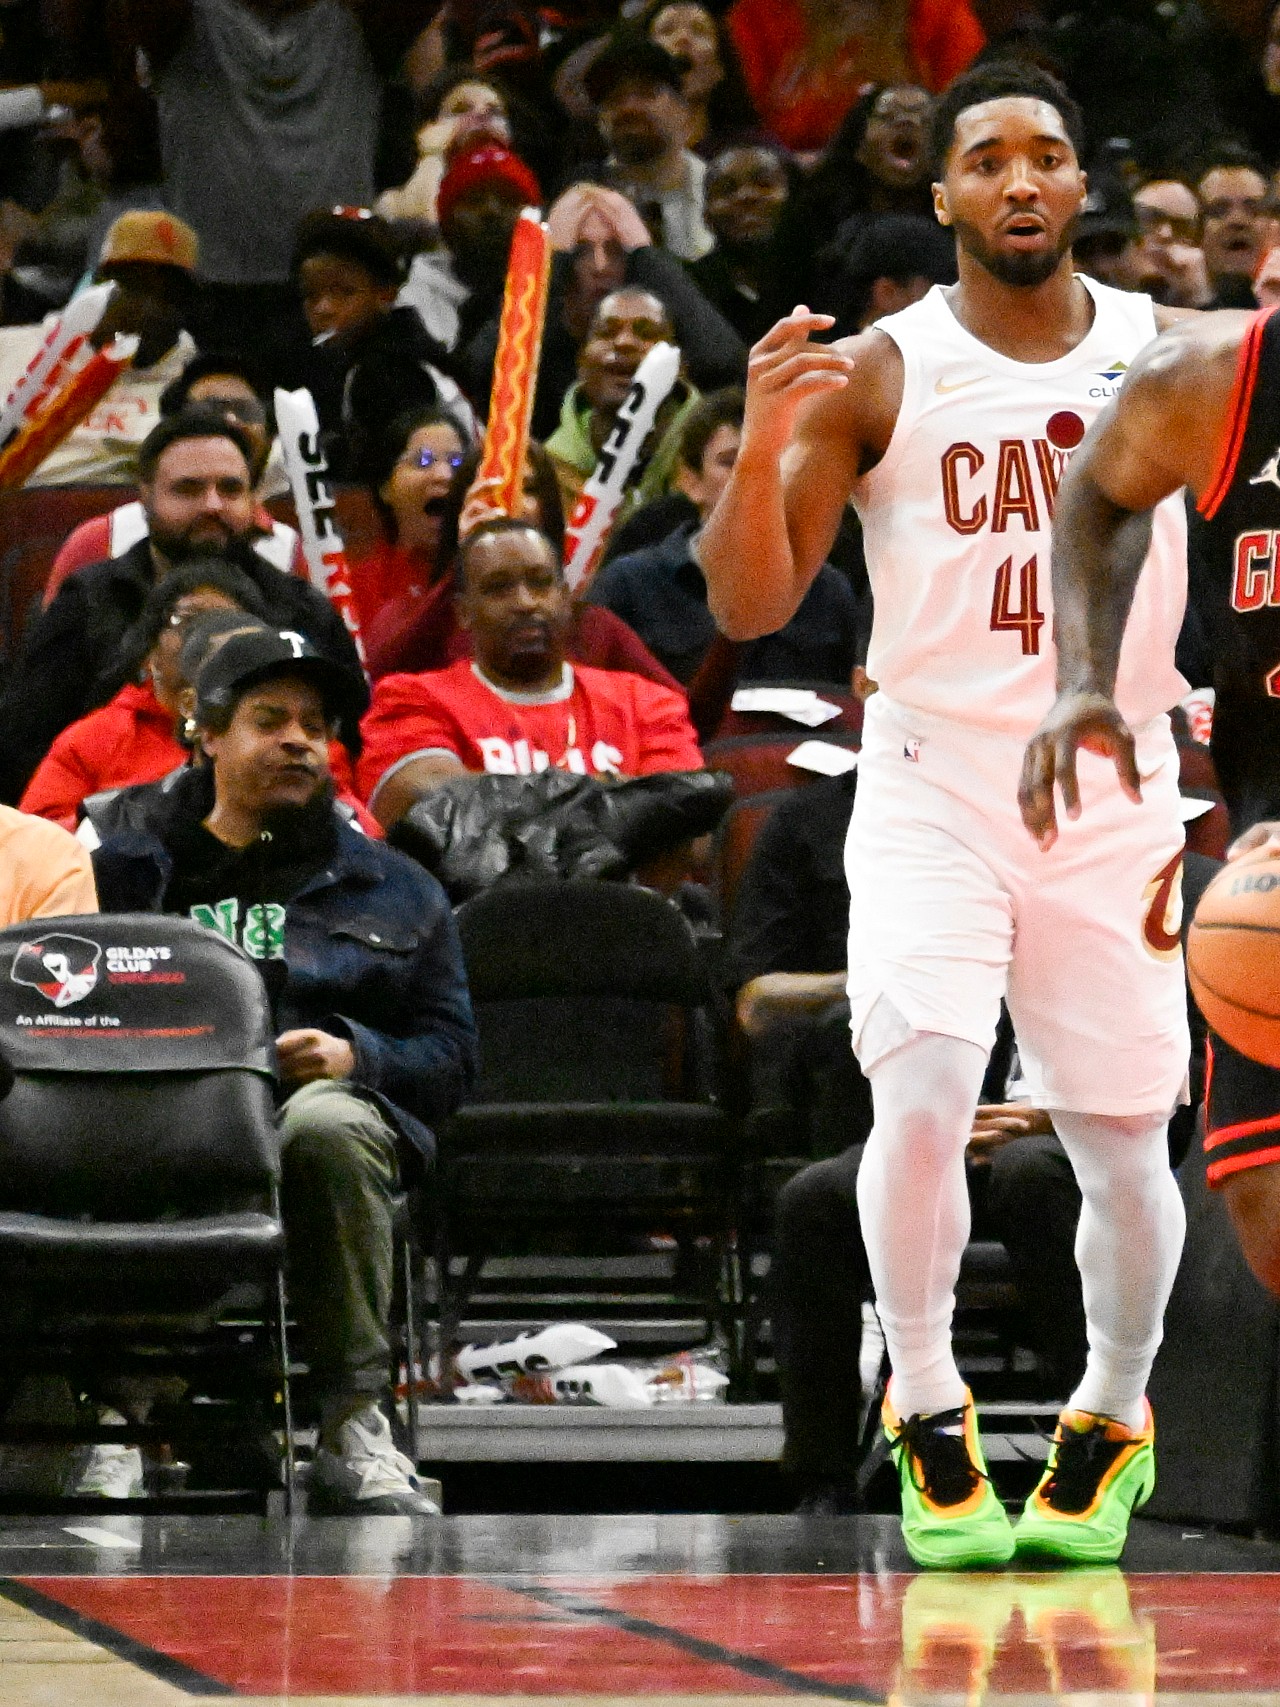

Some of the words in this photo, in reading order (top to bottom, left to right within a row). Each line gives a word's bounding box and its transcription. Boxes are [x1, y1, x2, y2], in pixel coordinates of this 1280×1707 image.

[941, 439, 1071, 535] CAV
[988, 554, 1057, 656] 4
[106, 947, 171, 960] GILDA'S
[106, 959, 152, 973] CLUB
[16, 1014, 33, 1026] An
[35, 1014, 83, 1027] Affiliate
[84, 1015, 97, 1027] of
[99, 1015, 121, 1027] the
